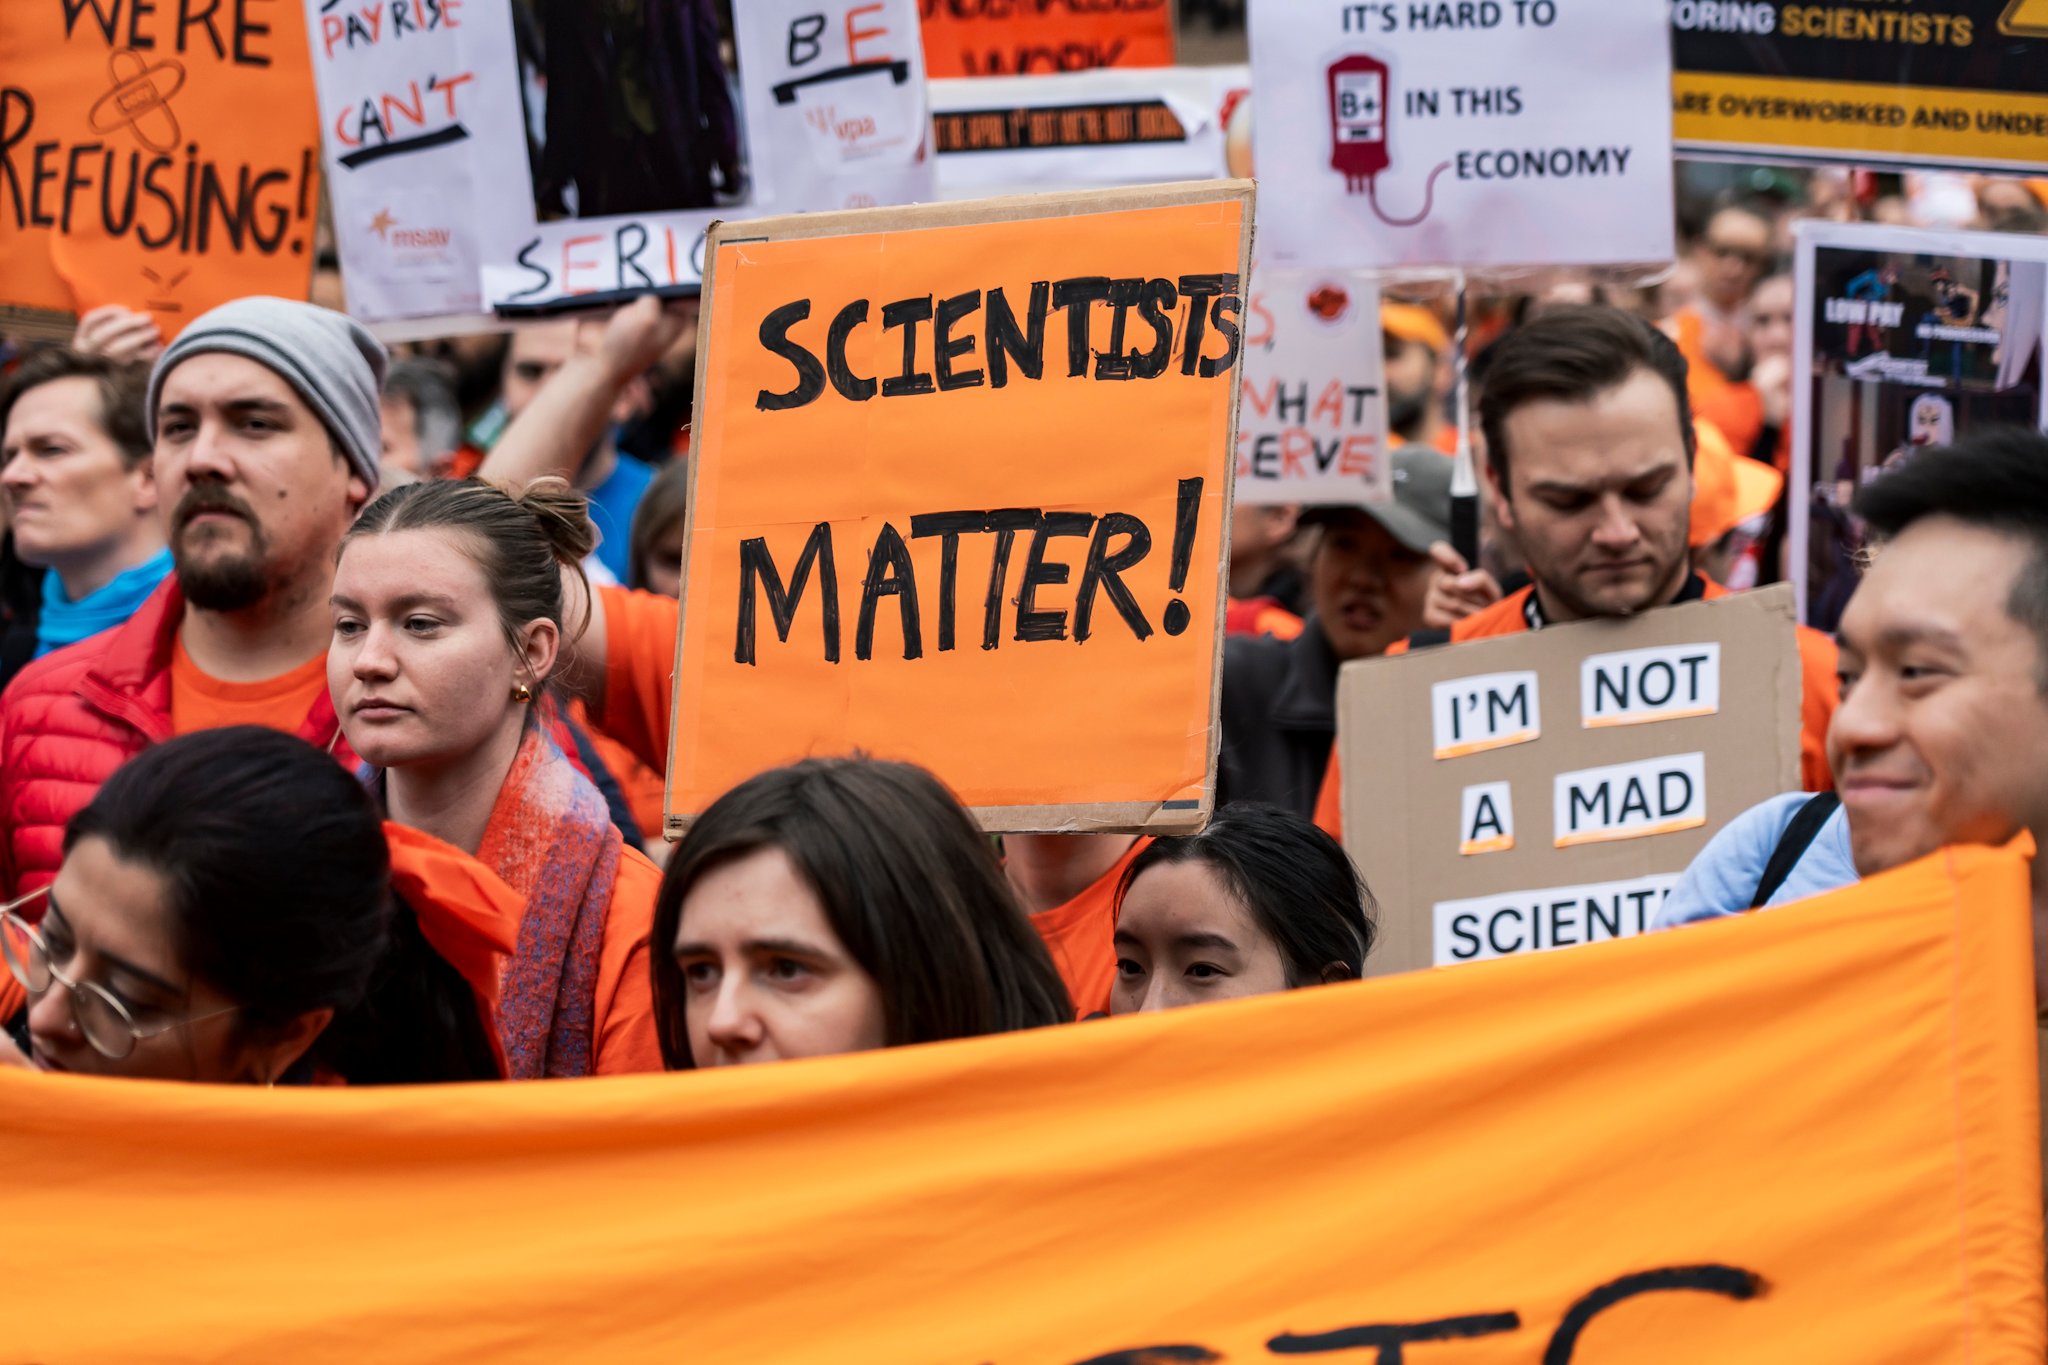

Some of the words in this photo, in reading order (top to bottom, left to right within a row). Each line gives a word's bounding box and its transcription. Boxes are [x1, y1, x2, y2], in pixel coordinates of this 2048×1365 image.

[1342, 2, 1398, 33] IT'S
[1408, 1, 1501, 30] HARD
[1514, 0, 1557, 27] TO
[1781, 5, 1974, 47] SCIENTISTS
[335, 72, 474, 146] CAN'T
[1405, 91, 1439, 117] IN
[1453, 87, 1524, 116] THIS
[1717, 94, 1906, 127] OVERWORKED
[1913, 104, 1971, 131] AND
[0, 87, 312, 255] REFUSING!
[1456, 147, 1630, 179] ECONOMY
[508, 223, 706, 301] SERI
[754, 272, 1243, 411] SCIENTISTS
[734, 476, 1204, 666] MATTER!
[1451, 683, 1529, 740] I'M
[1594, 655, 1710, 713] NOT
[1470, 794, 1505, 841] A
[1569, 770, 1693, 831] MAD
[1451, 888, 1672, 960] SCIENT
